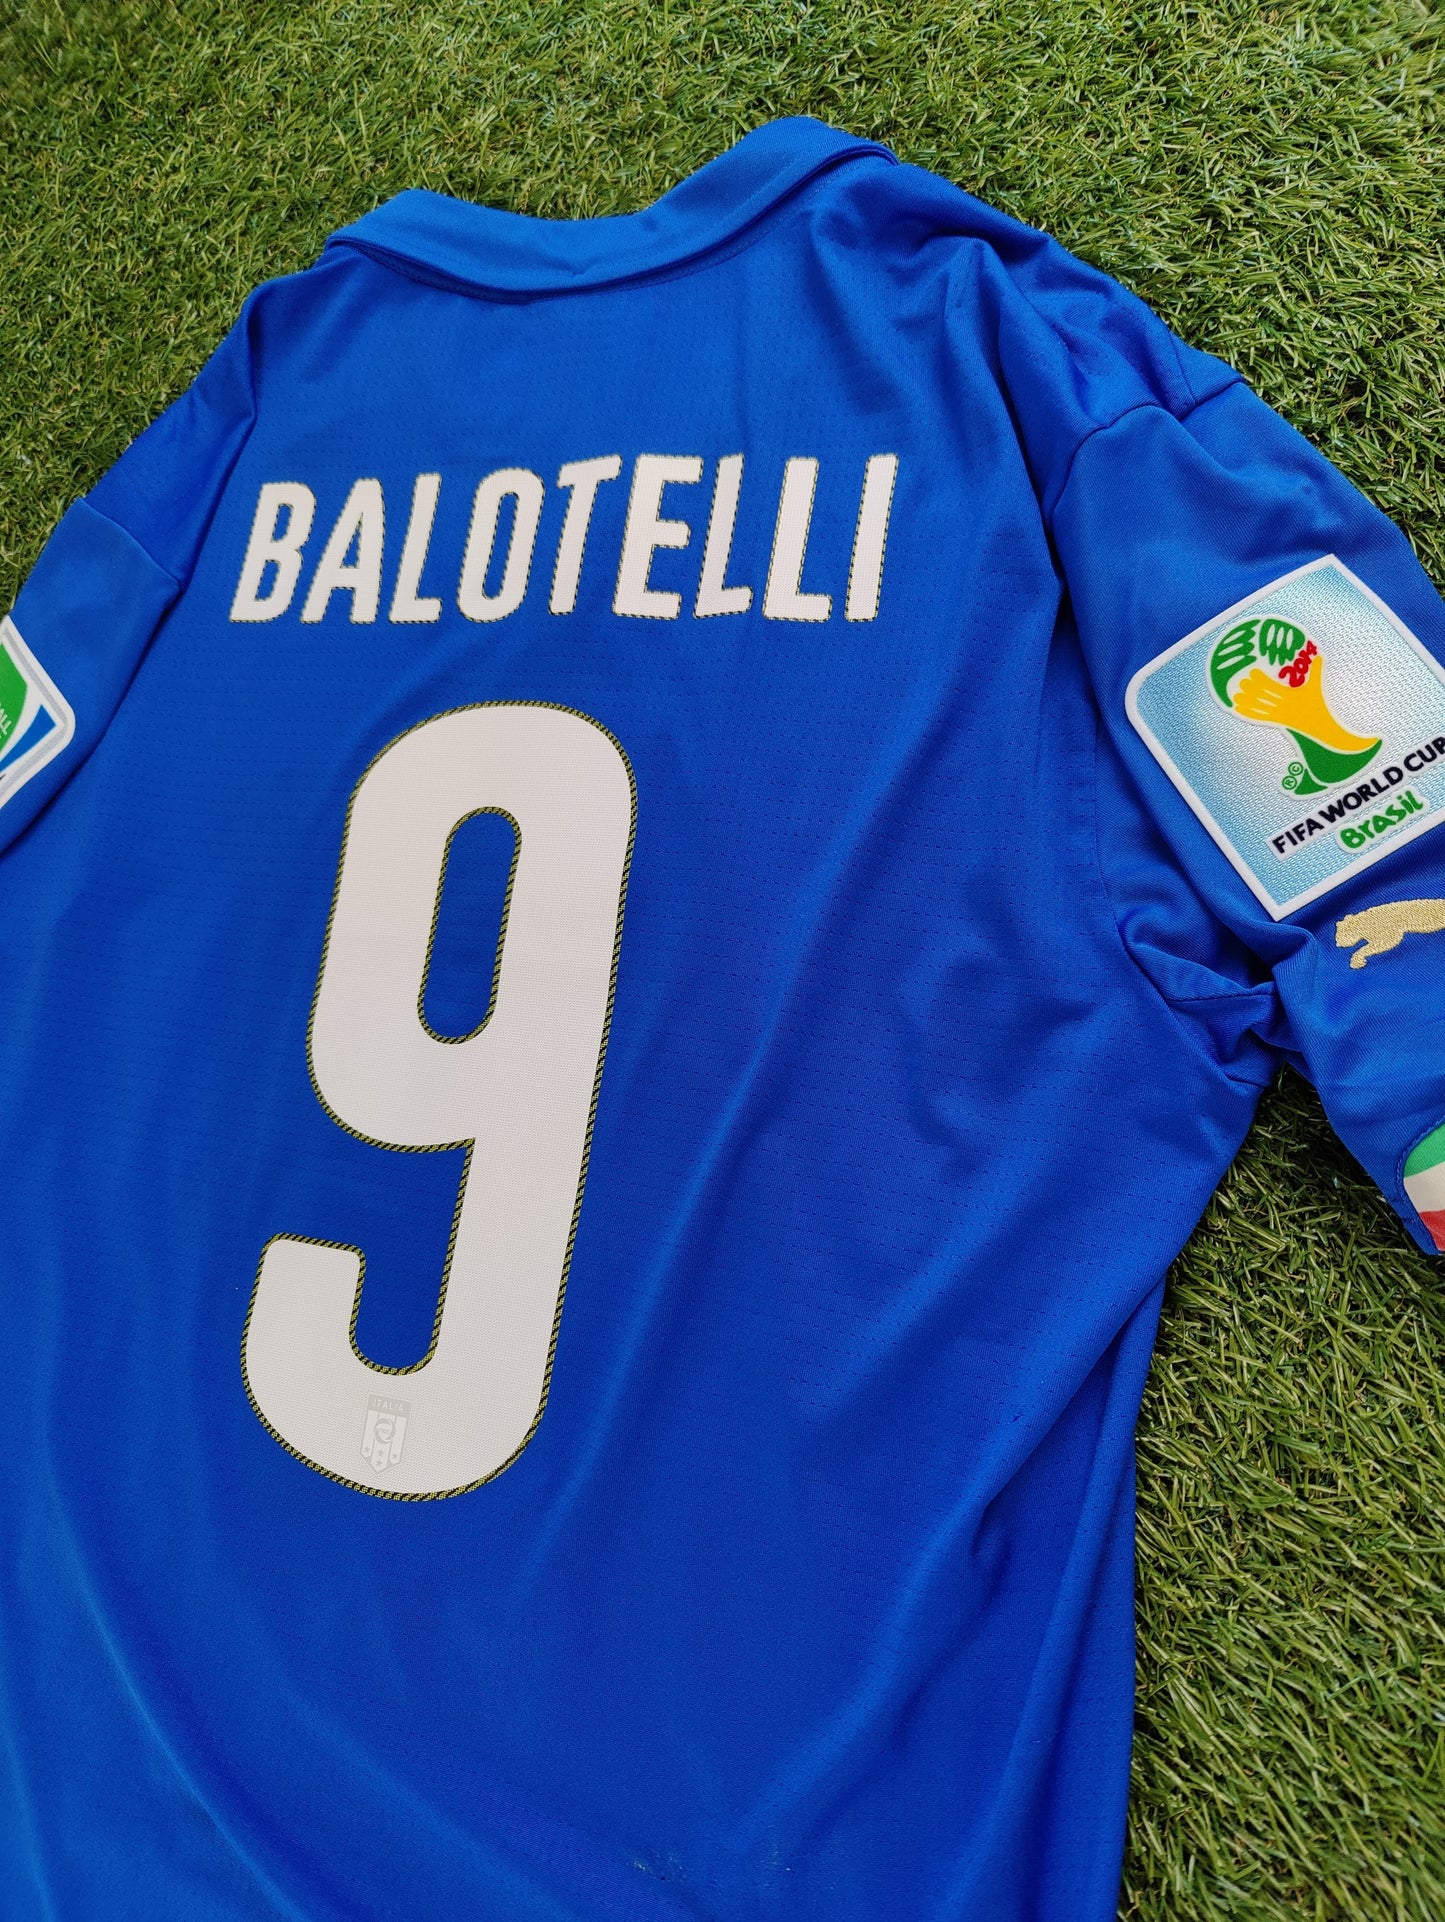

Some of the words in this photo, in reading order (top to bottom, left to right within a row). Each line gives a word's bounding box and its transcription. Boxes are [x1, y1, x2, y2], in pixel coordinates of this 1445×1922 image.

[228, 452, 900, 625] BALOTELLI
[1278, 640, 1318, 688] 2014
[1272, 818, 1325, 854] FIFA
[1318, 766, 1404, 824] WORLD
[1403, 736, 1445, 772] CUP
[1340, 790, 1424, 849] Brasil
[242, 700, 638, 1501] 9
[372, 1398, 404, 1412] ITALIA
